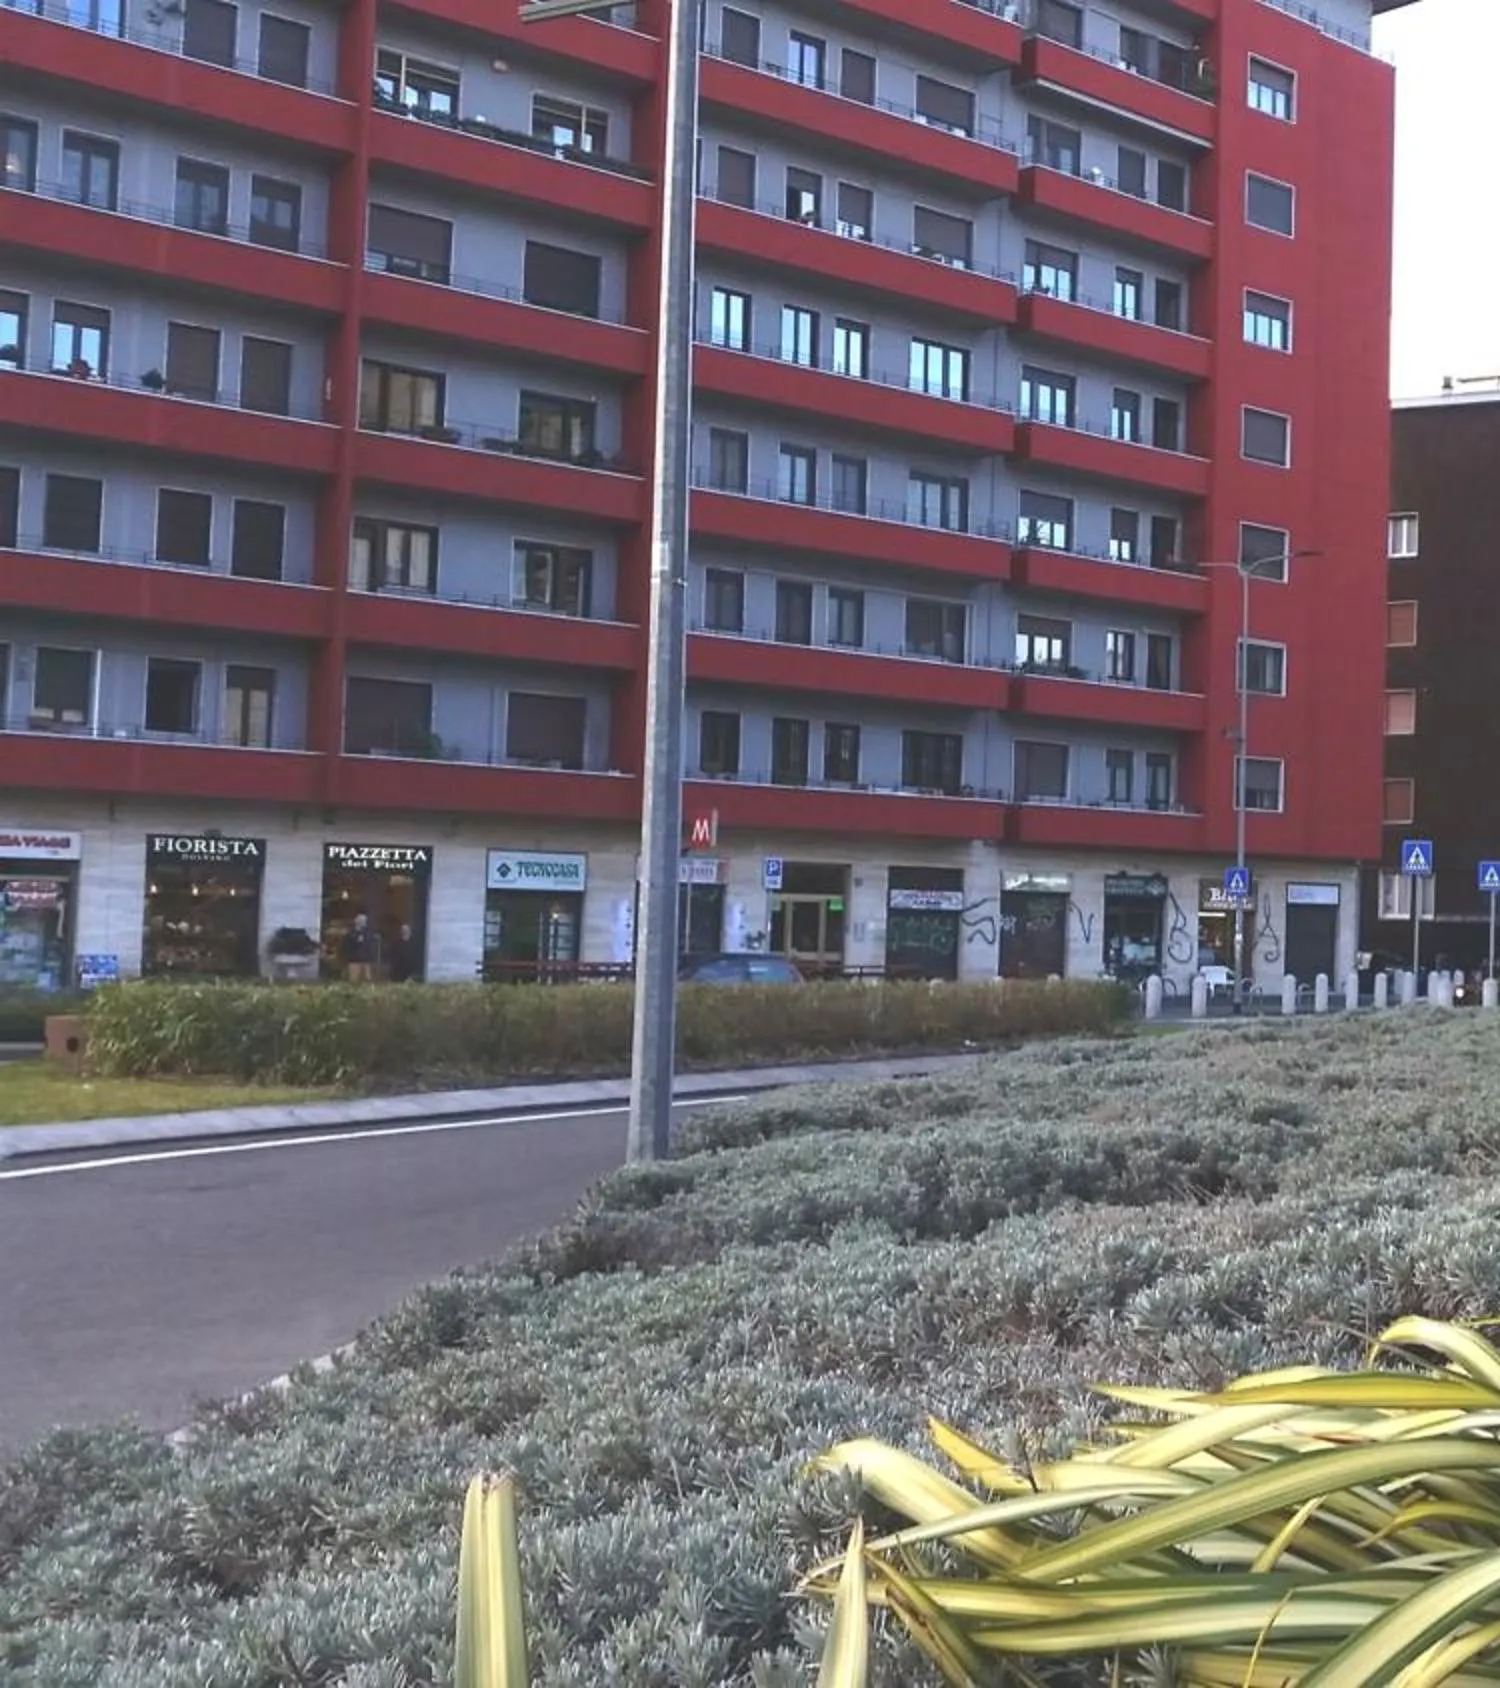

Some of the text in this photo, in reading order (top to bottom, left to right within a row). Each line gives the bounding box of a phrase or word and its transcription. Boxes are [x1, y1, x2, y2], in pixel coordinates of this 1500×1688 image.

[691, 818, 710, 841] M
[153, 837, 259, 856] FIORISTA
[328, 845, 428, 861] PIAZZETTA
[516, 861, 580, 878] TECNOCASA
